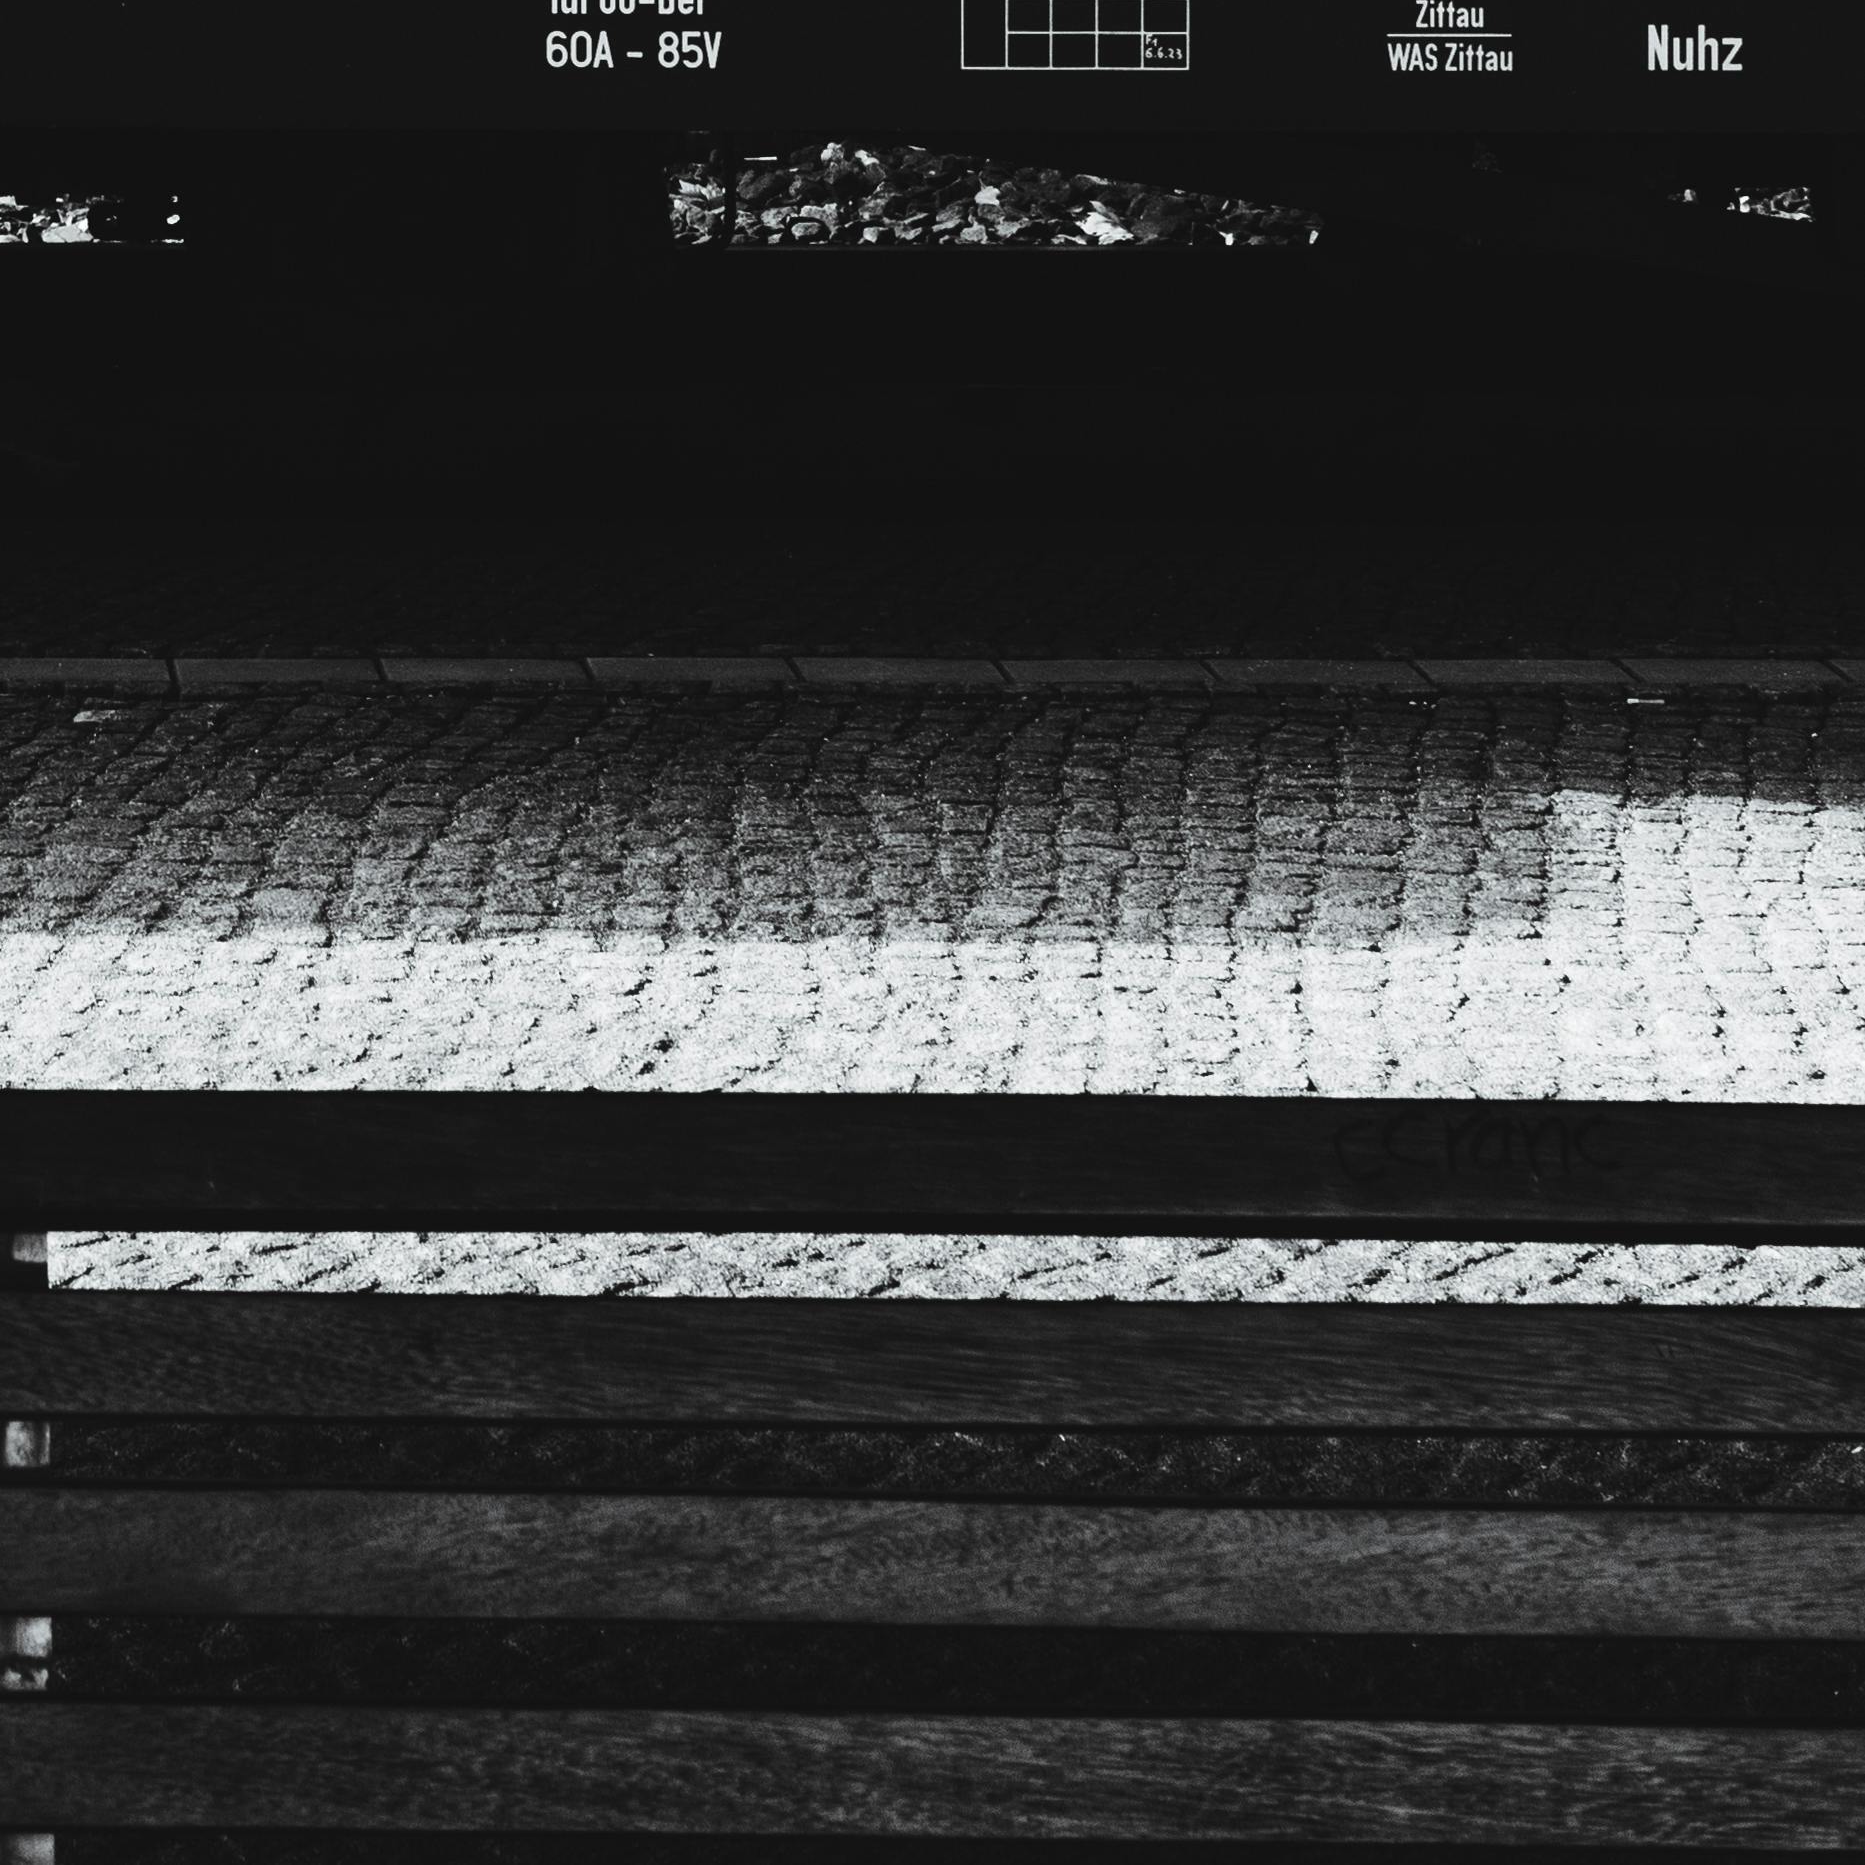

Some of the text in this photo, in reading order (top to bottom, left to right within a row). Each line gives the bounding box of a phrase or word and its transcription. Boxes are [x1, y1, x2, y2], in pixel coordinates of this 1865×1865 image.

[1415, 0, 1485, 28] Zittau
[545, 31, 615, 70] 60A
[657, 31, 723, 70] 85V
[1145, 47, 1183, 60] 6.6.23
[1386, 42, 1514, 72] WAS Zittau
[1647, 24, 1744, 72] Nuhz
